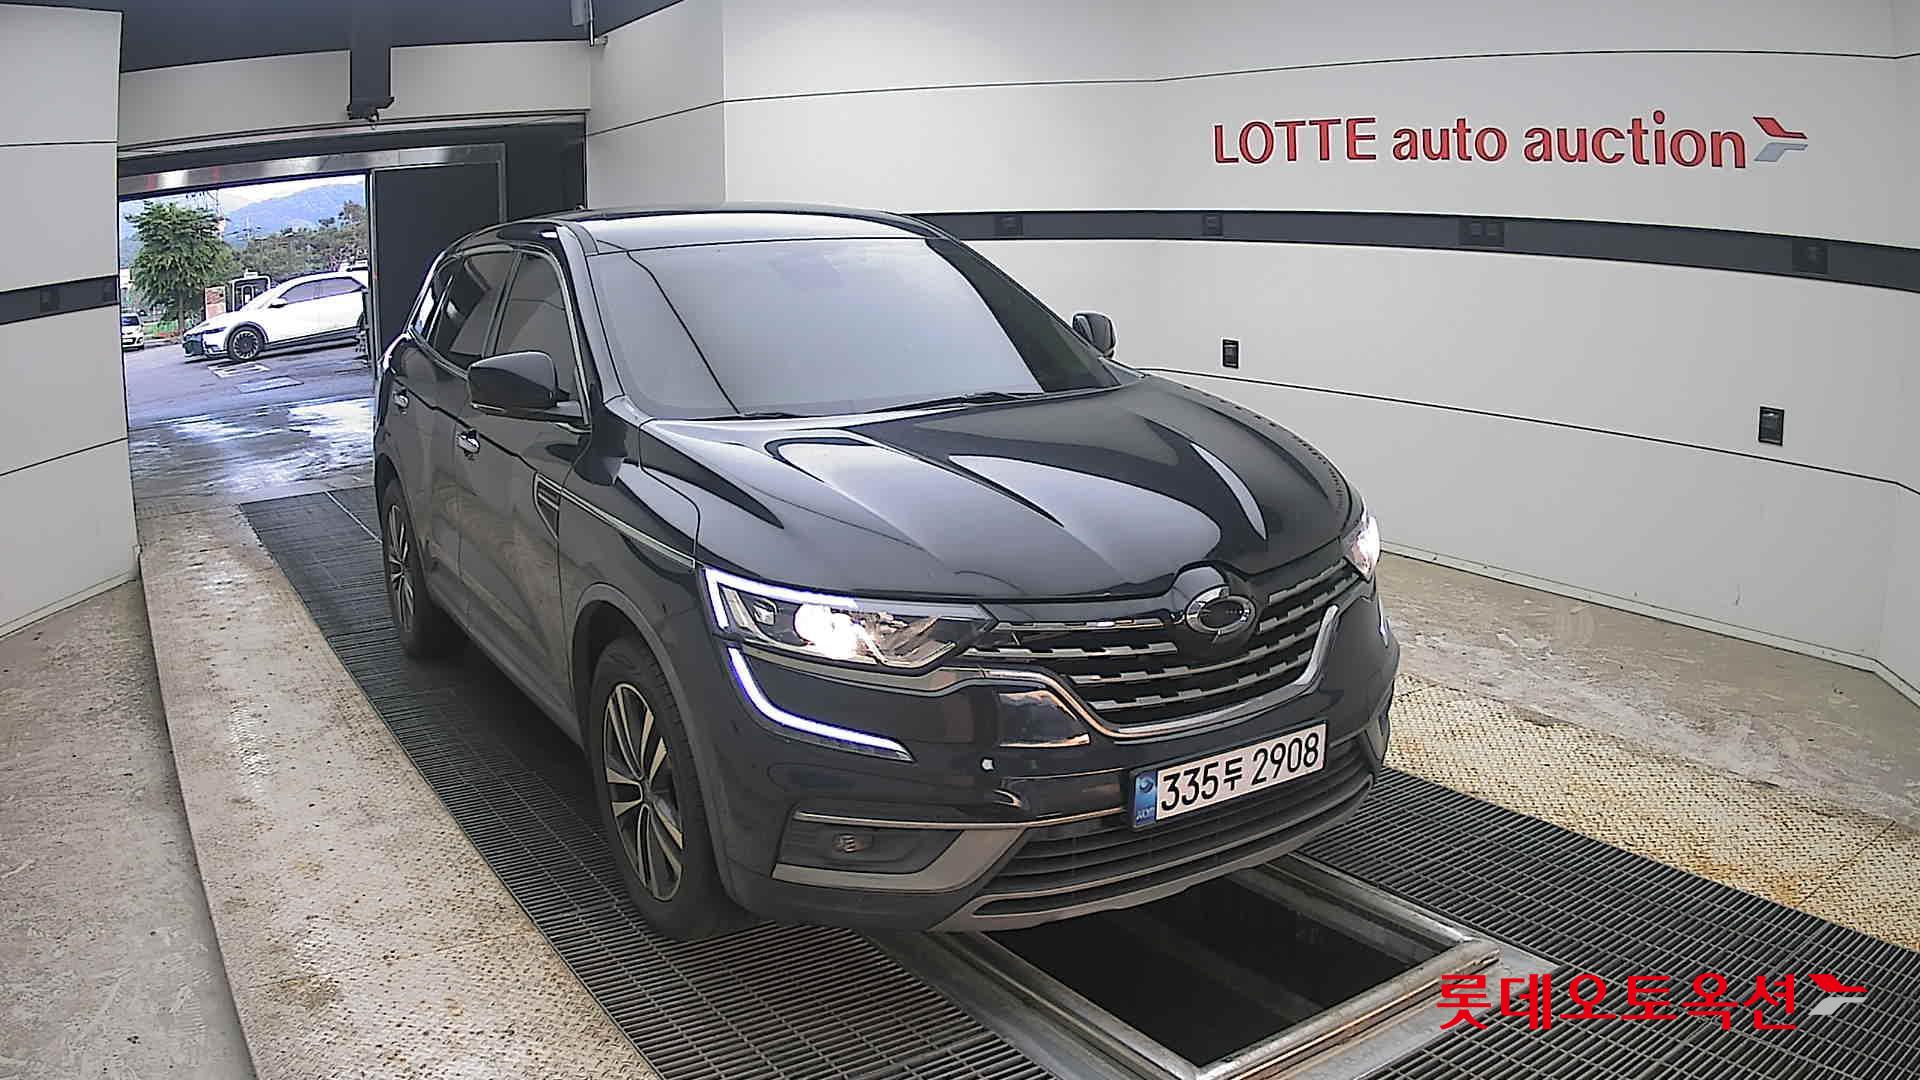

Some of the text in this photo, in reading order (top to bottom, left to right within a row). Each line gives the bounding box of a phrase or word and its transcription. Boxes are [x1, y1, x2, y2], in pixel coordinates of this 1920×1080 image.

[1214, 110, 1746, 169] LOTTE auto auction
[1161, 732, 1319, 811] 335두 2908
